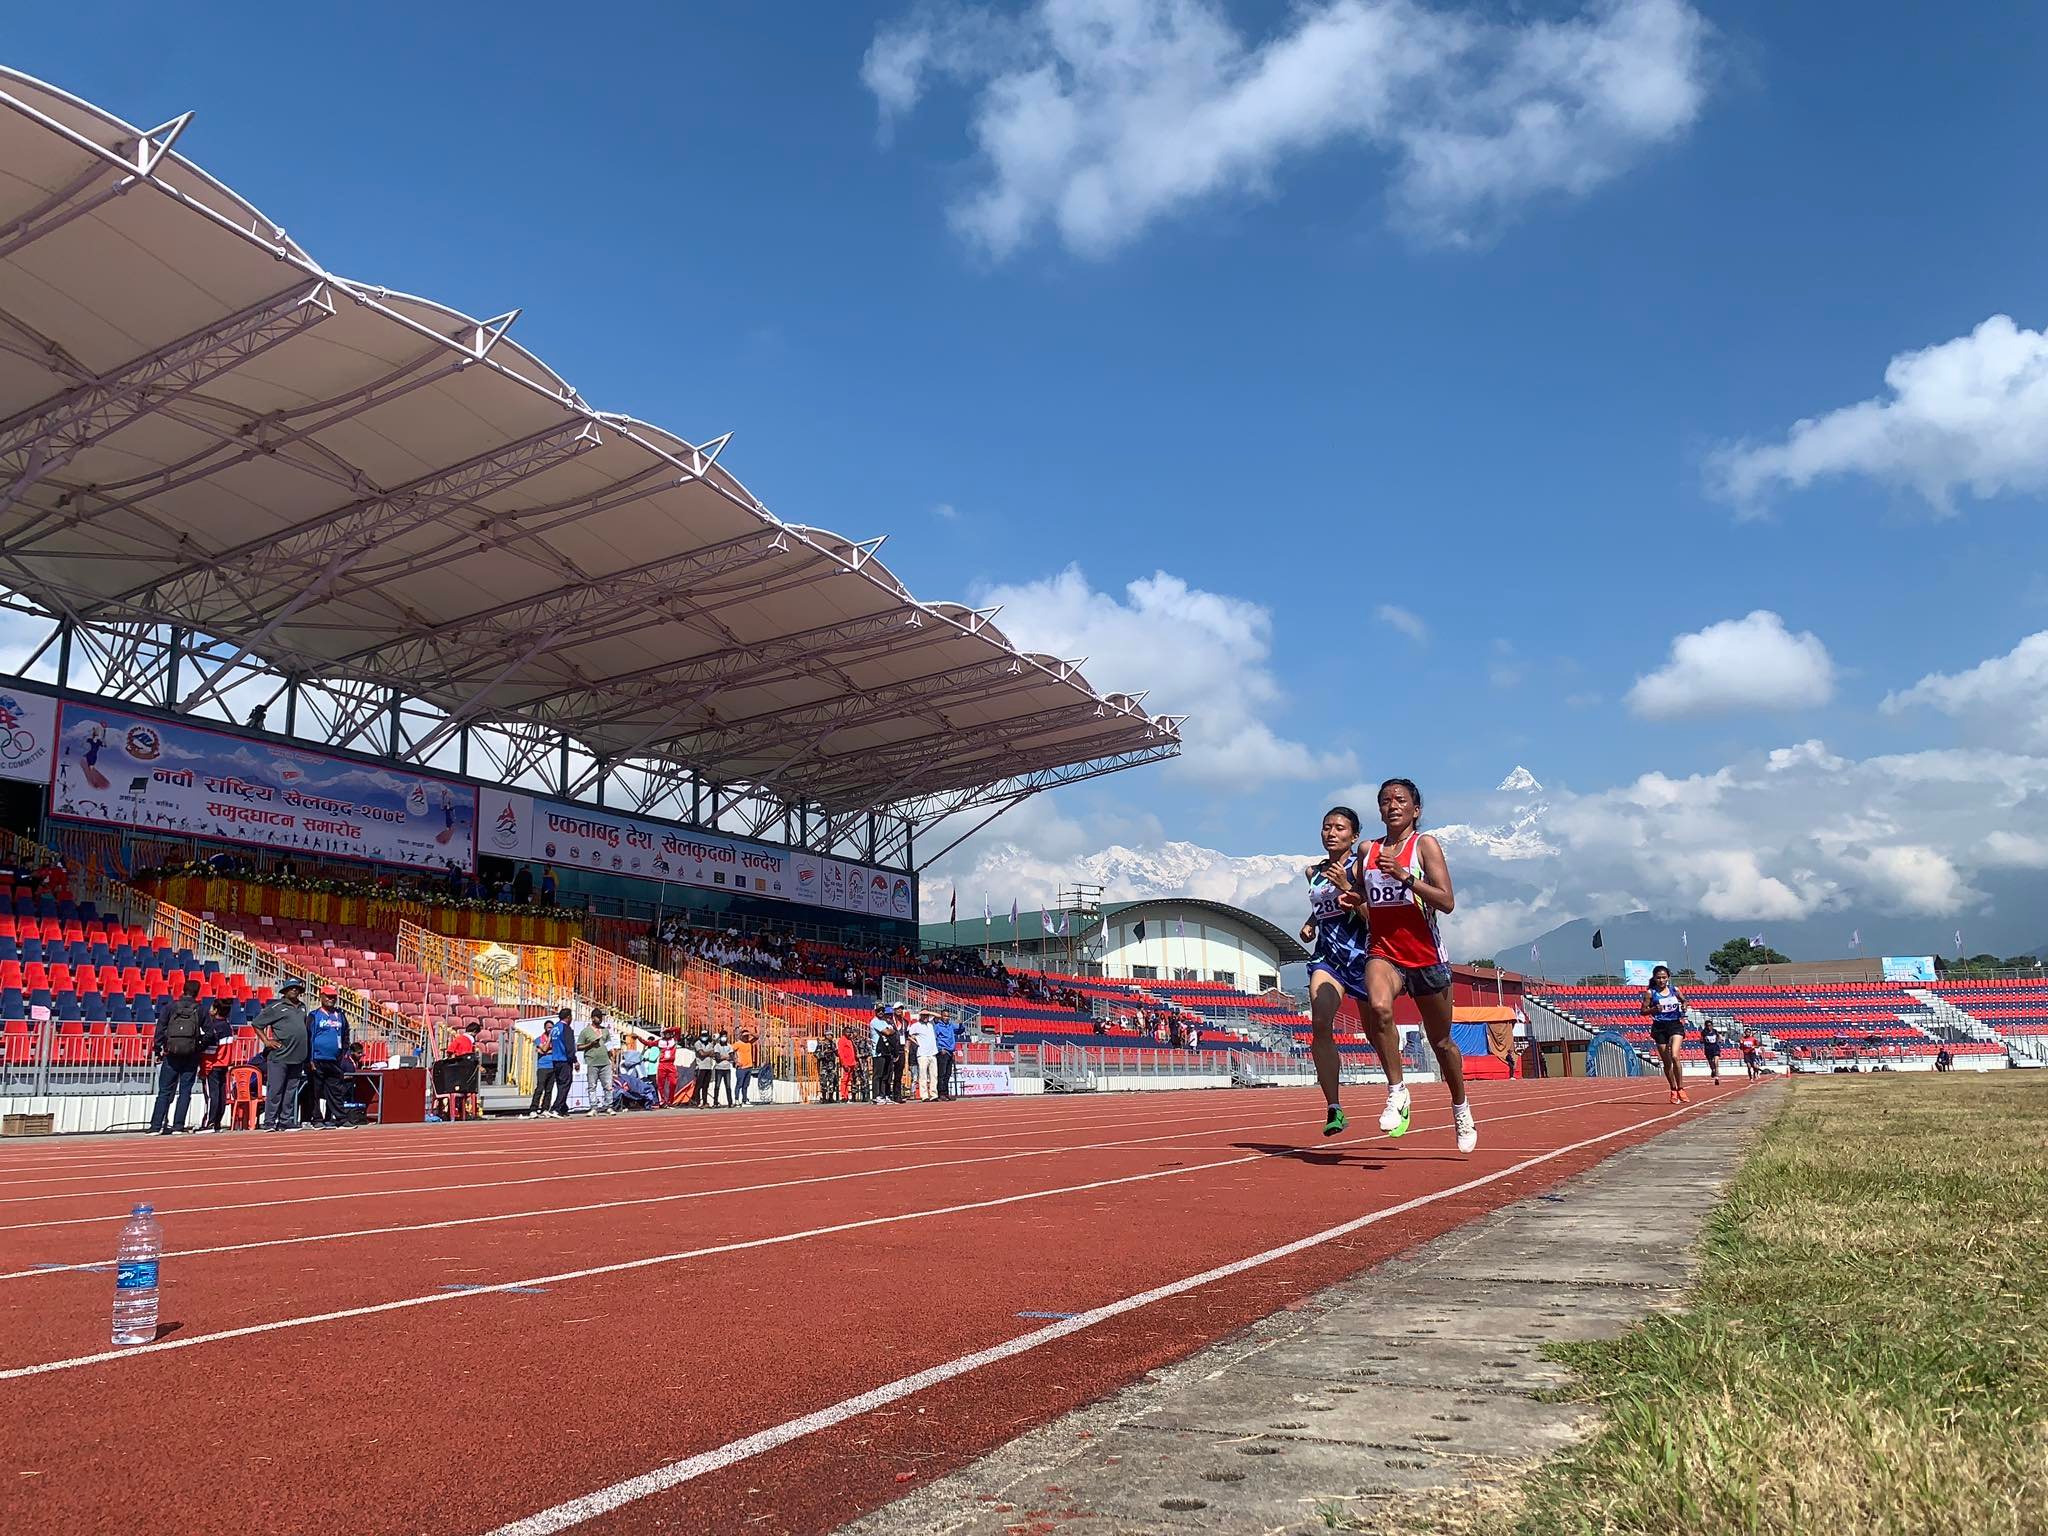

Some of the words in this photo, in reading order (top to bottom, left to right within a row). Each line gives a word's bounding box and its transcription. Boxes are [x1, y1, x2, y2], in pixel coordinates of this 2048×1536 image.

[9, 746, 47, 769] COMMITTEE
[204, 777, 274, 803] राष्ट्रिय
[302, 817, 362, 839] समारोह
[661, 831, 737, 865] खेलकुदको
[1370, 886, 1407, 902] 087
